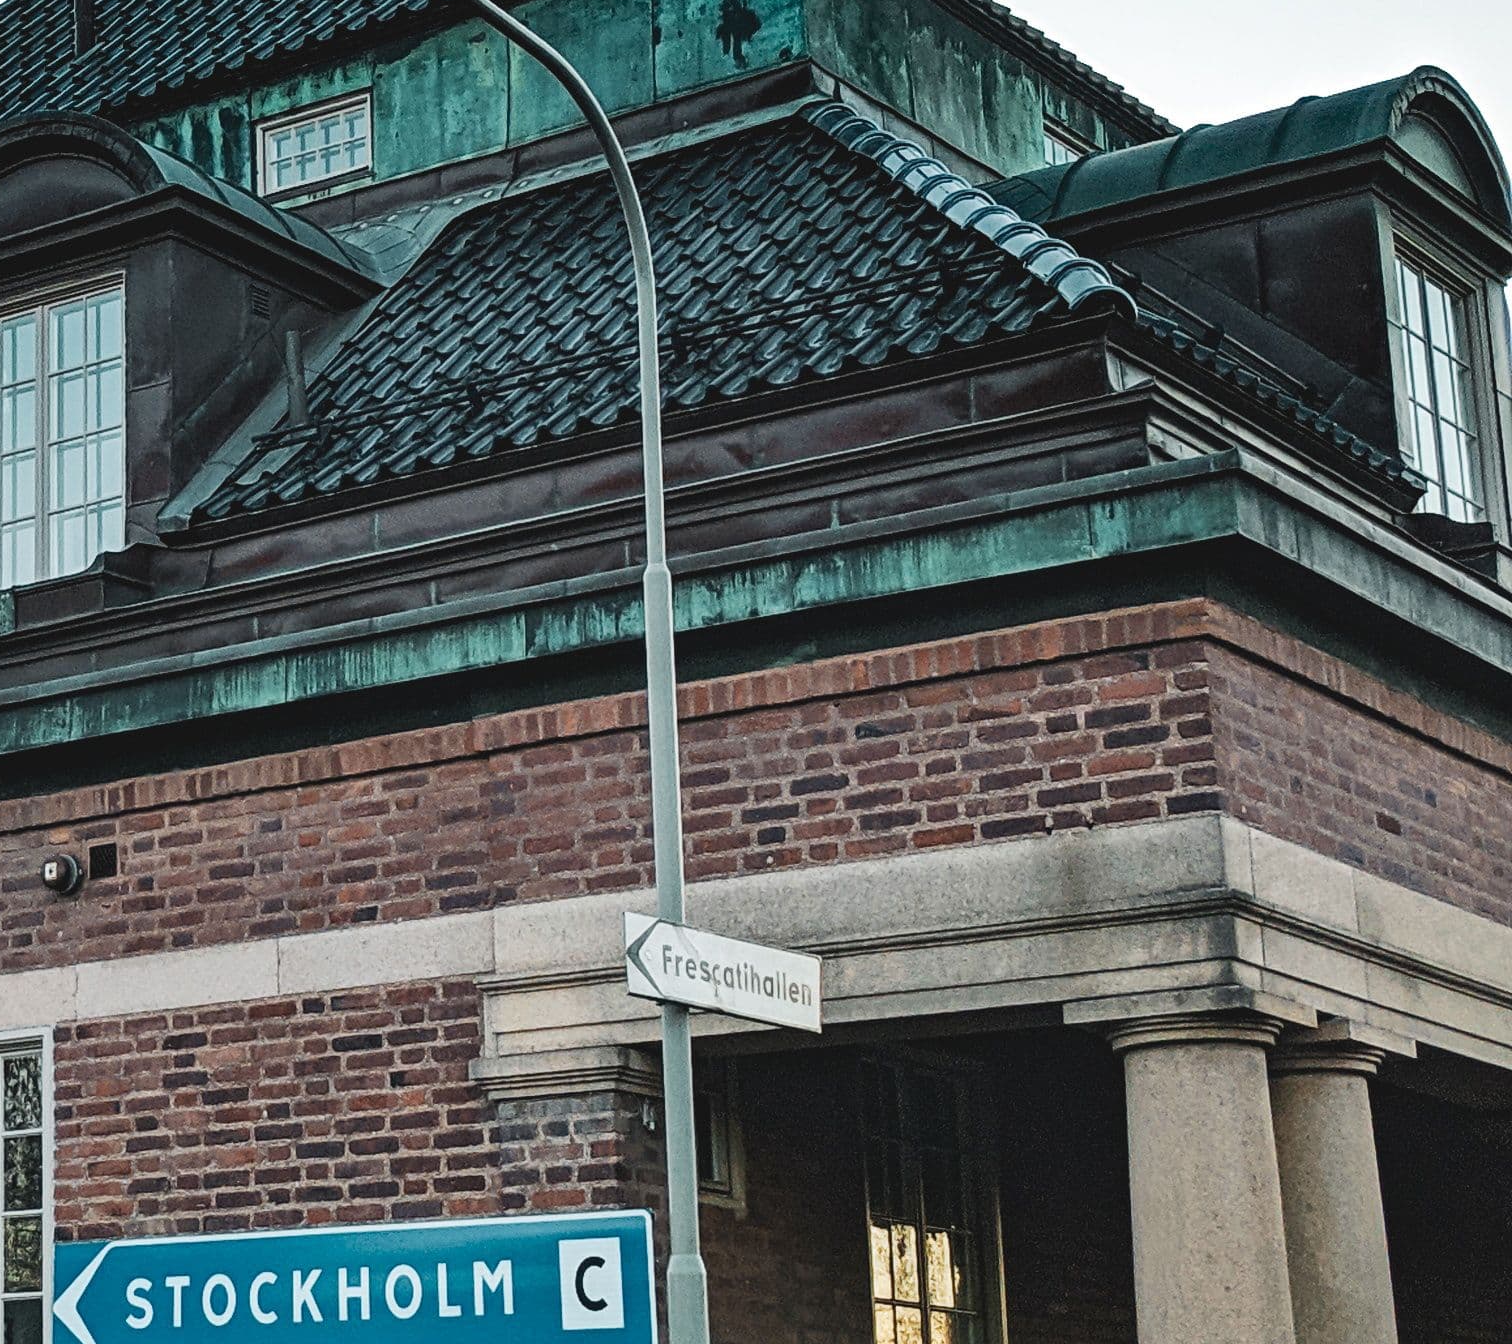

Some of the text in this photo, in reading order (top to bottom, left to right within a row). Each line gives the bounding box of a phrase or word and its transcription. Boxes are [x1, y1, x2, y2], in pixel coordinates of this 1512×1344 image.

[661, 944, 812, 1006] Frescatihallen
[125, 1256, 607, 1330] STOCKHOLM C
